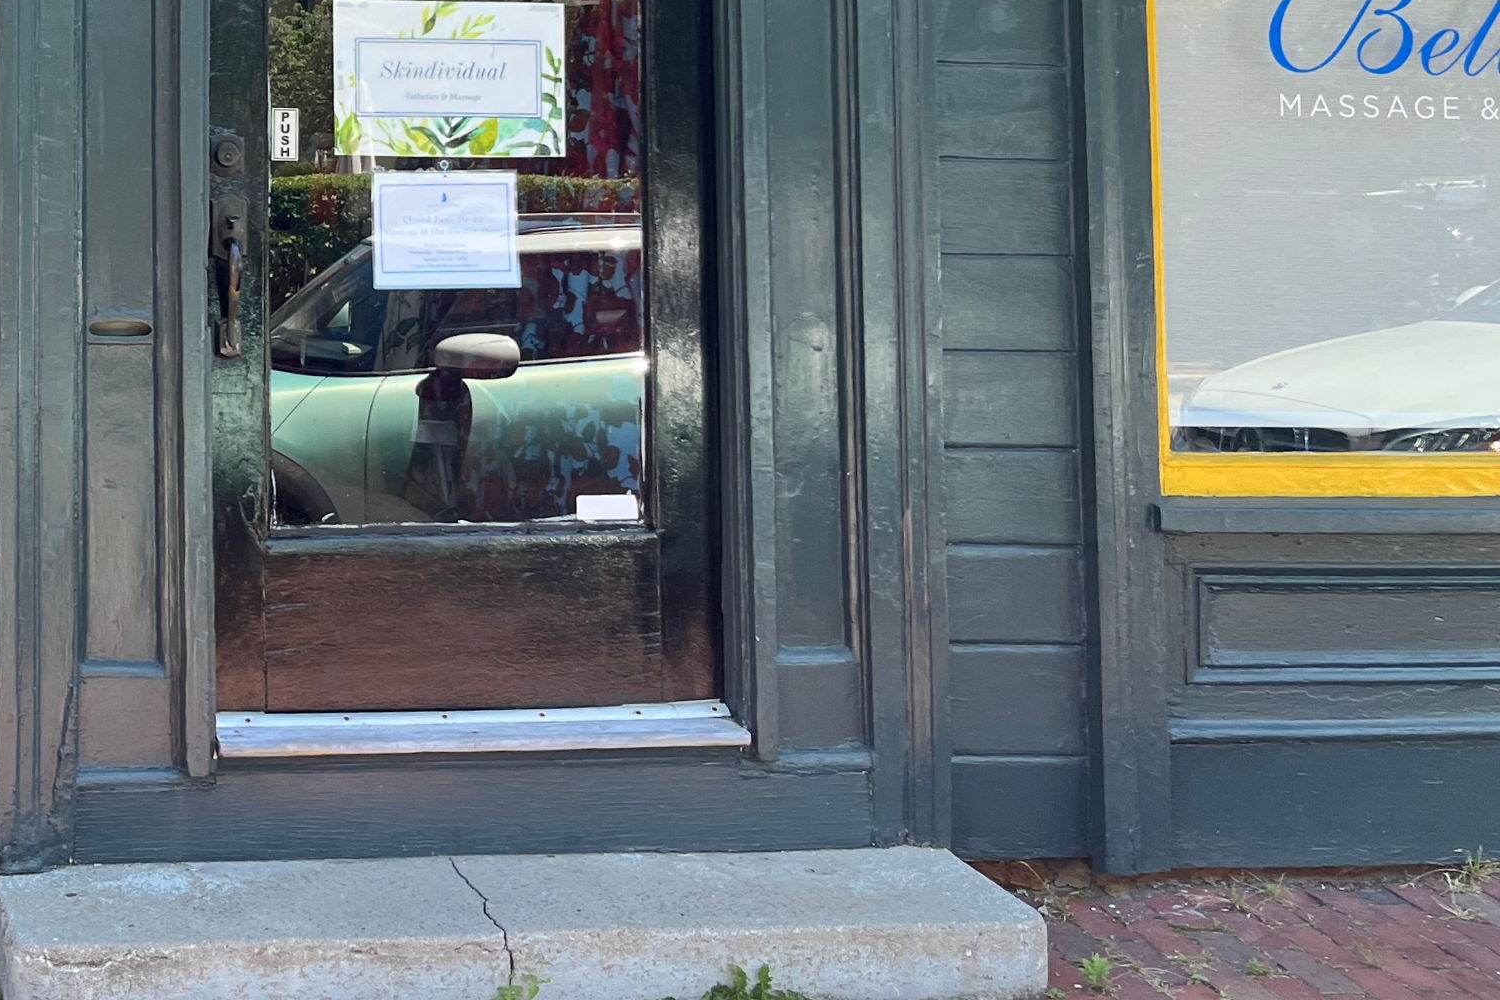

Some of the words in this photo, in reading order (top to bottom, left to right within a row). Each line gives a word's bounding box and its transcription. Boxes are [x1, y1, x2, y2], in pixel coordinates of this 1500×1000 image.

[380, 60, 507, 81] Skindividual
[1279, 93, 1461, 120] MASSAGE
[1480, 96, 1500, 120] &
[280, 111, 290, 157] PUSH
